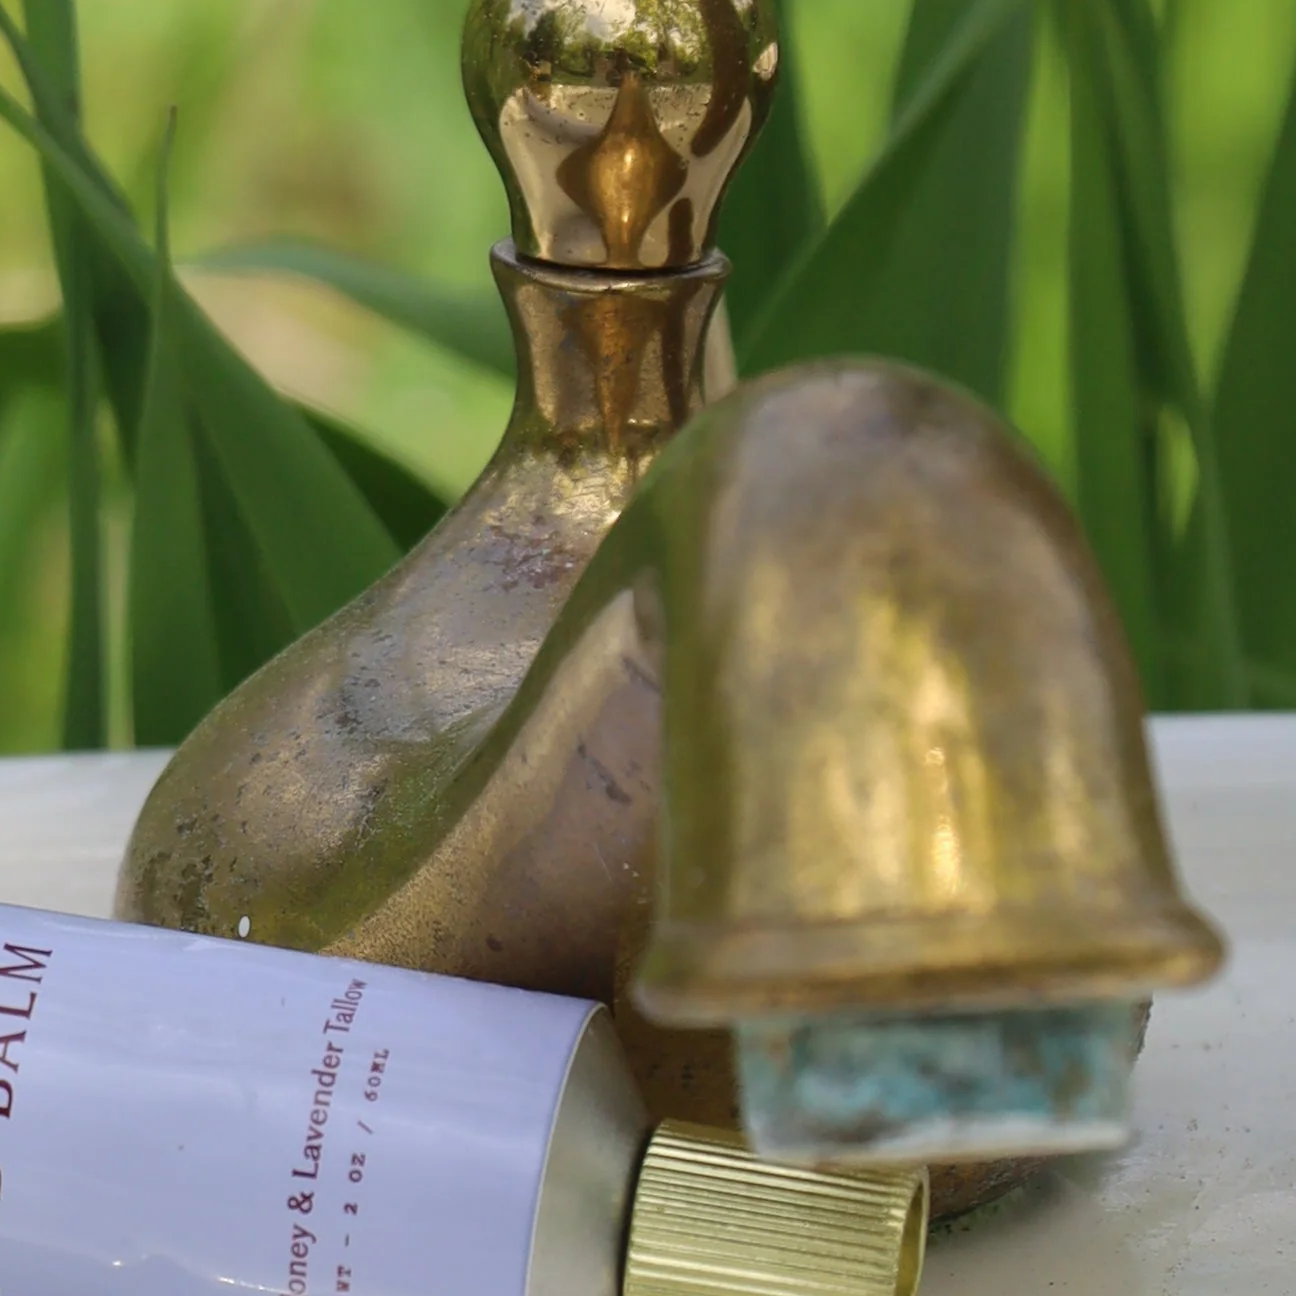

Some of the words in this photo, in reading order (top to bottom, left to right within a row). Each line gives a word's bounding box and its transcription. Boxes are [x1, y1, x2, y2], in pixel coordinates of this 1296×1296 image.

[323, 978, 368, 1035] Tallow
[364, 1048, 391, 1103] 60ML
[291, 1041, 345, 1180] Lavender
[286, 1190, 315, 1215] &
[343, 1202, 359, 1216] 2
[336, 1265, 352, 1293] WT
